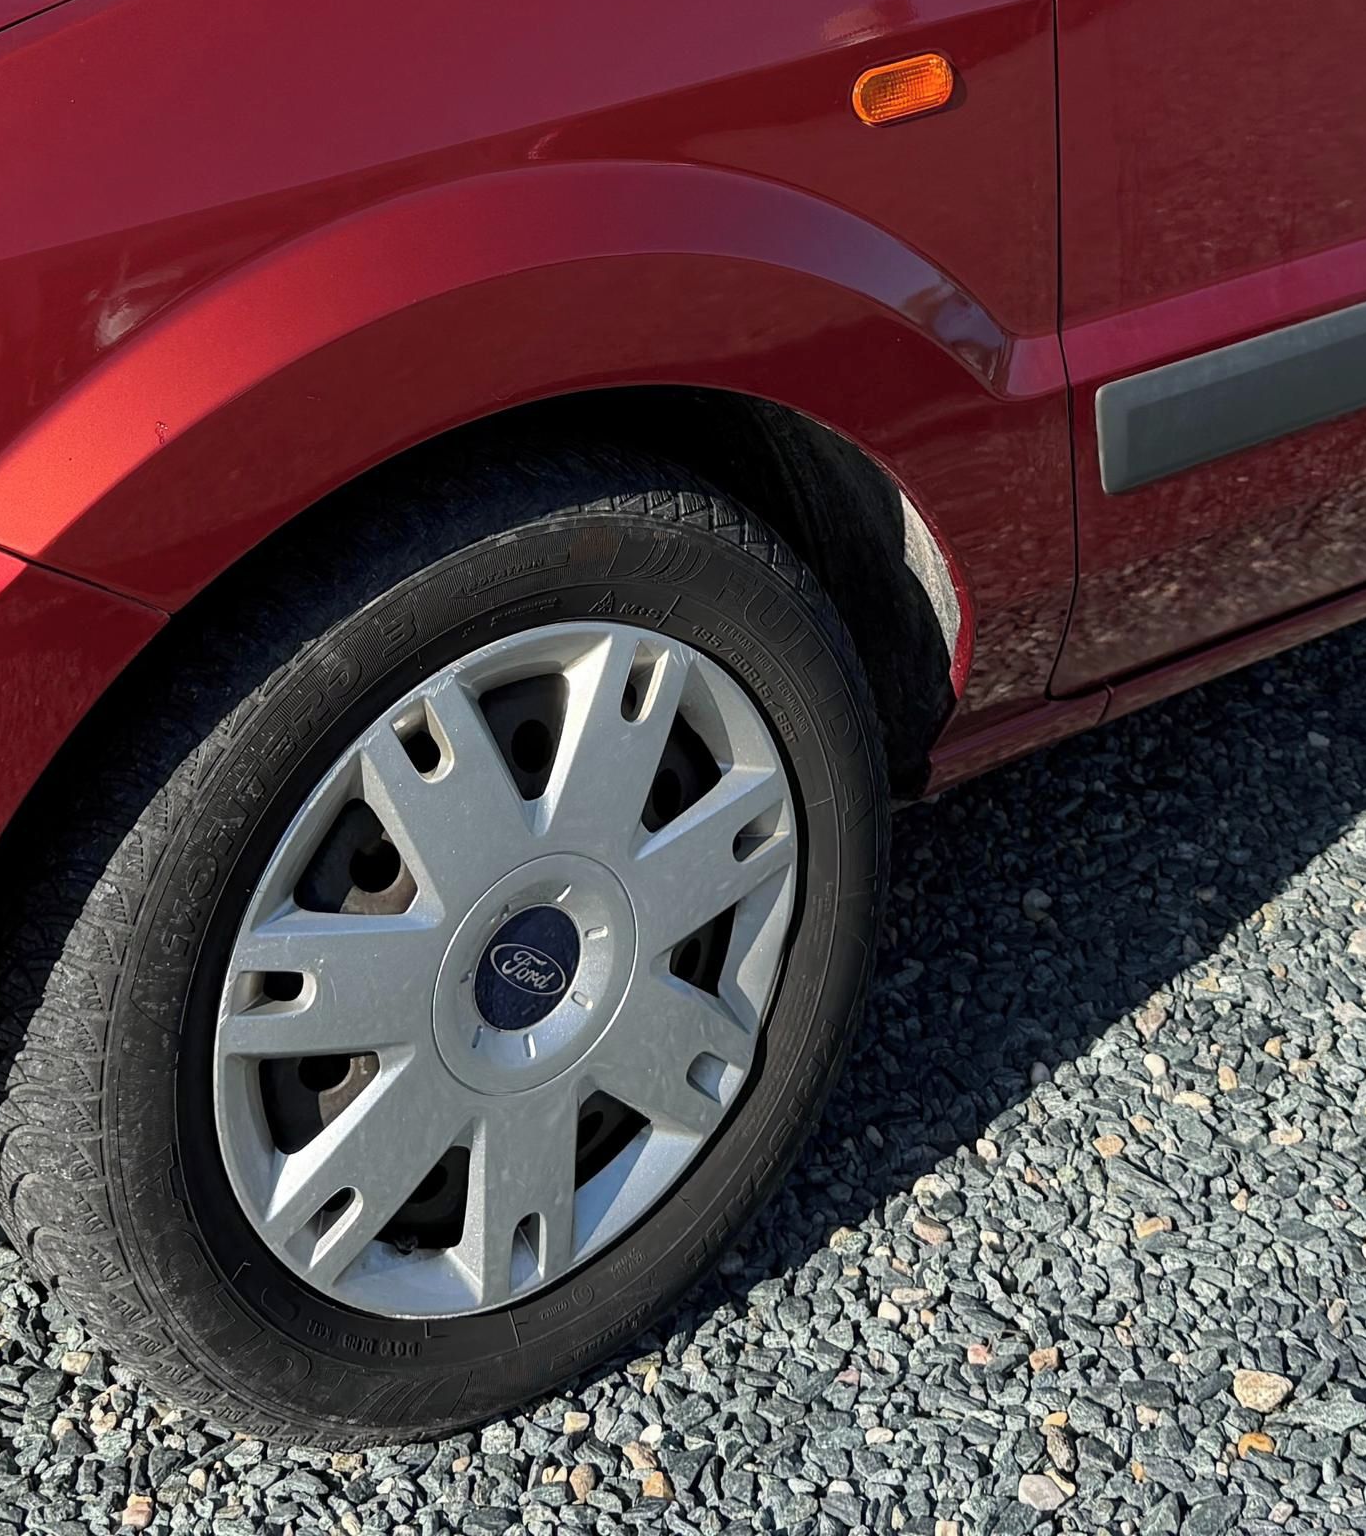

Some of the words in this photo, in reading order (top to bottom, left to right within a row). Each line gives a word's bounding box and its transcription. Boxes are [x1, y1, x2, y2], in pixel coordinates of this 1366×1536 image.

[160, 655, 364, 956] MONTERO
[379, 610, 417, 657] 3
[716, 570, 874, 833] FULDA
[502, 950, 555, 990] Ford
